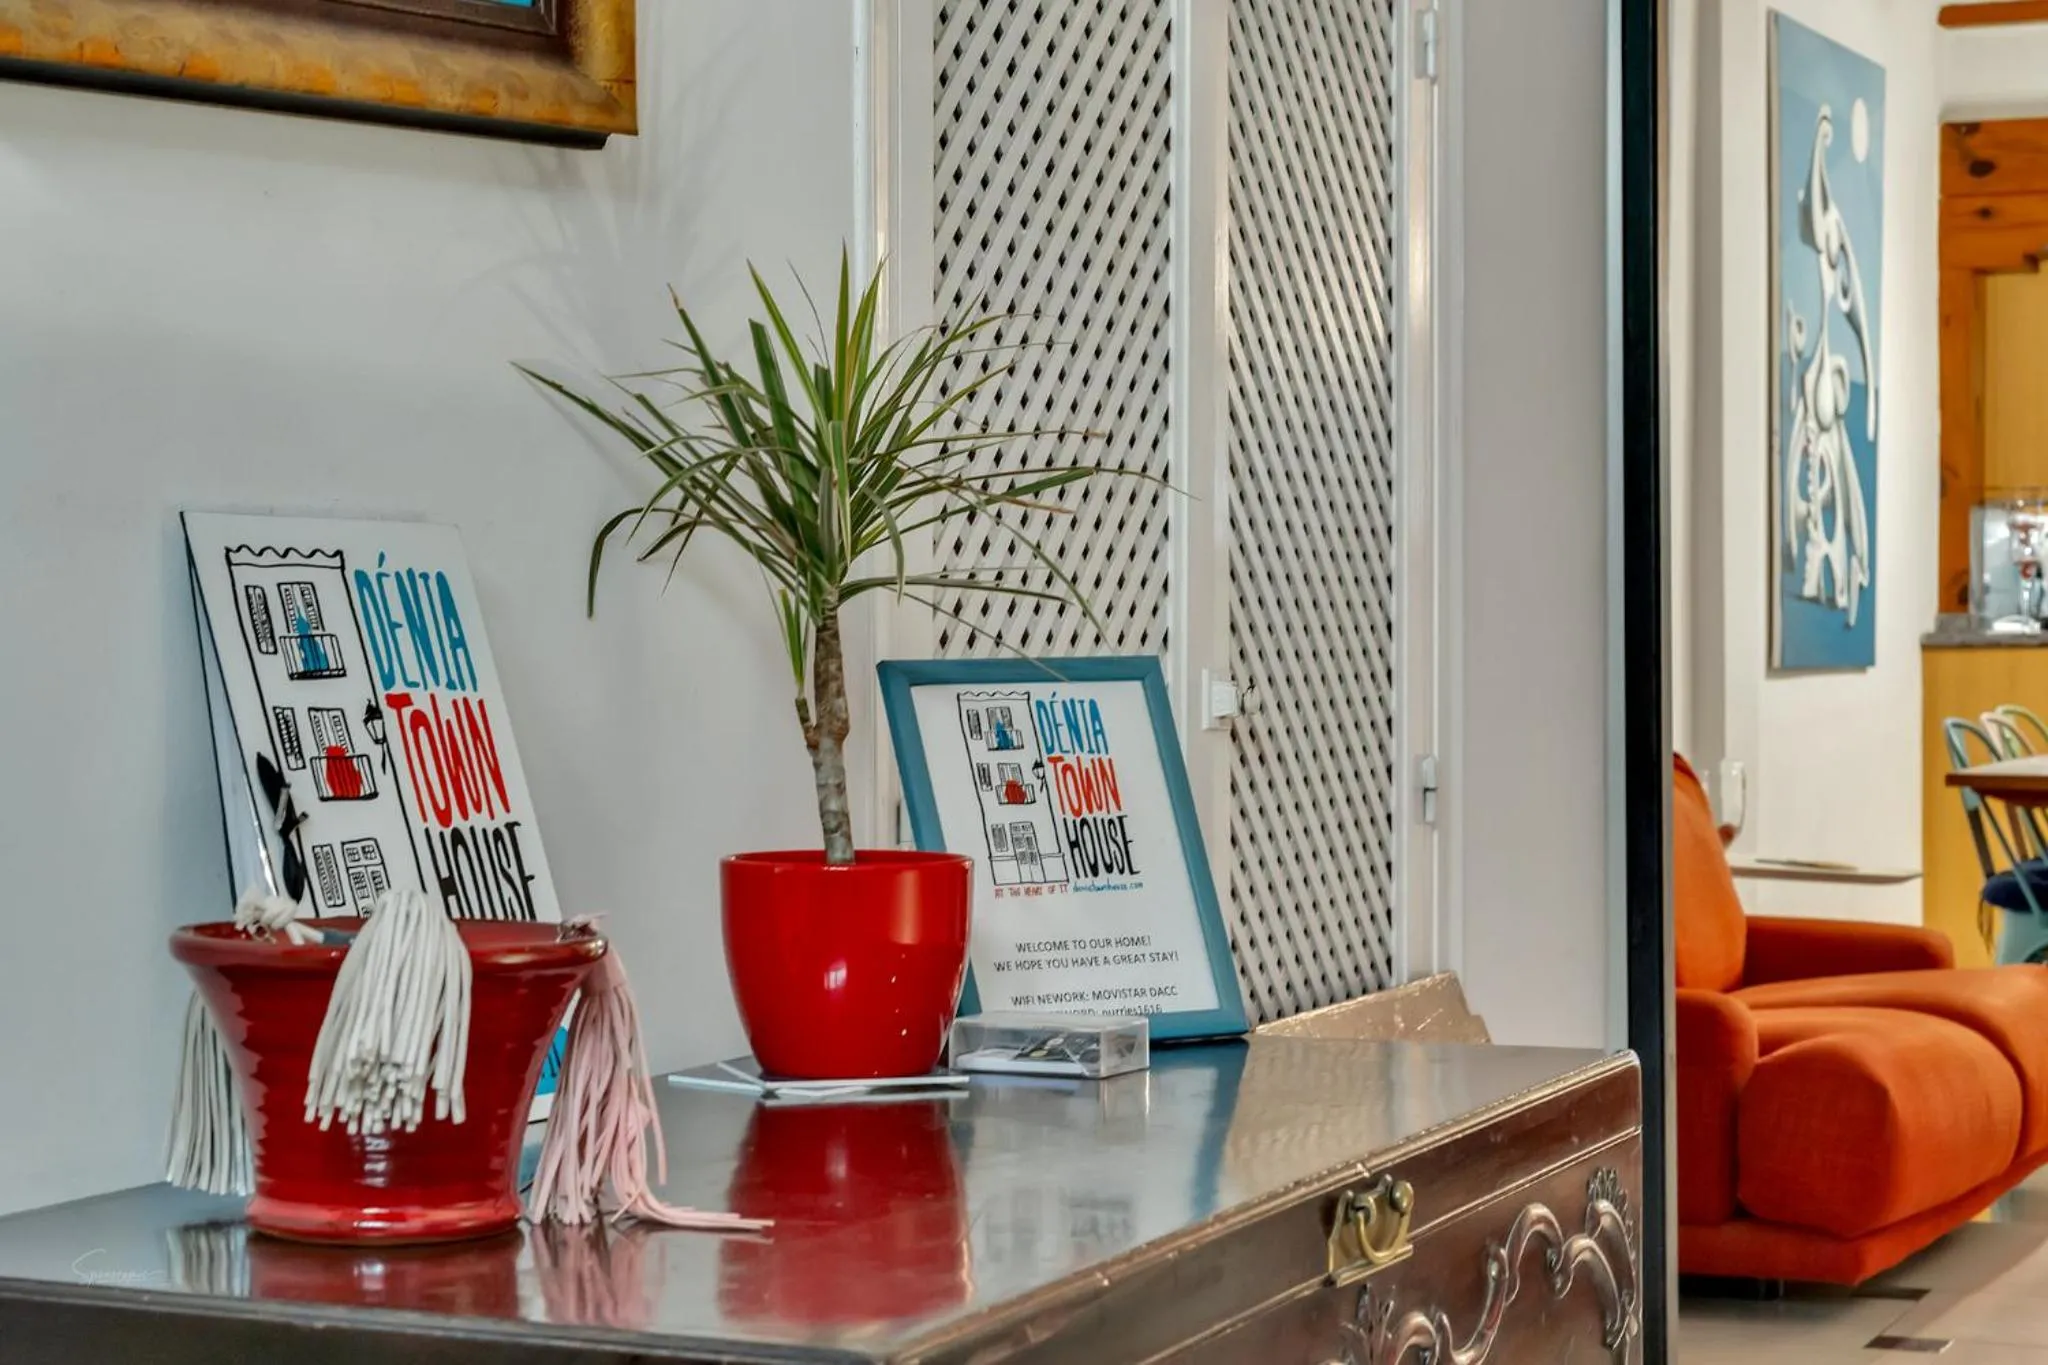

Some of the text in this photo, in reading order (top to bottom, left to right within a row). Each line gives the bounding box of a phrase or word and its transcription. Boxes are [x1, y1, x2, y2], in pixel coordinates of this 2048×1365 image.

[353, 551, 478, 692] DÉNIA
[1035, 691, 1109, 755] DÉNIA
[384, 692, 511, 829] TOWN
[1046, 755, 1122, 818] TOWN
[424, 821, 537, 921] HOUSE
[1062, 814, 1141, 879] HOUSE
[994, 950, 1180, 972] WE HOPE YOU HAVE A GREAT STAY!
[1015, 935, 1151, 953] WELCOME TO OUR HOME!
[1011, 994, 1036, 1007] WIFI
[1037, 991, 1089, 1005] NEWORK:
[1092, 987, 1148, 1001] MOVISTAR
